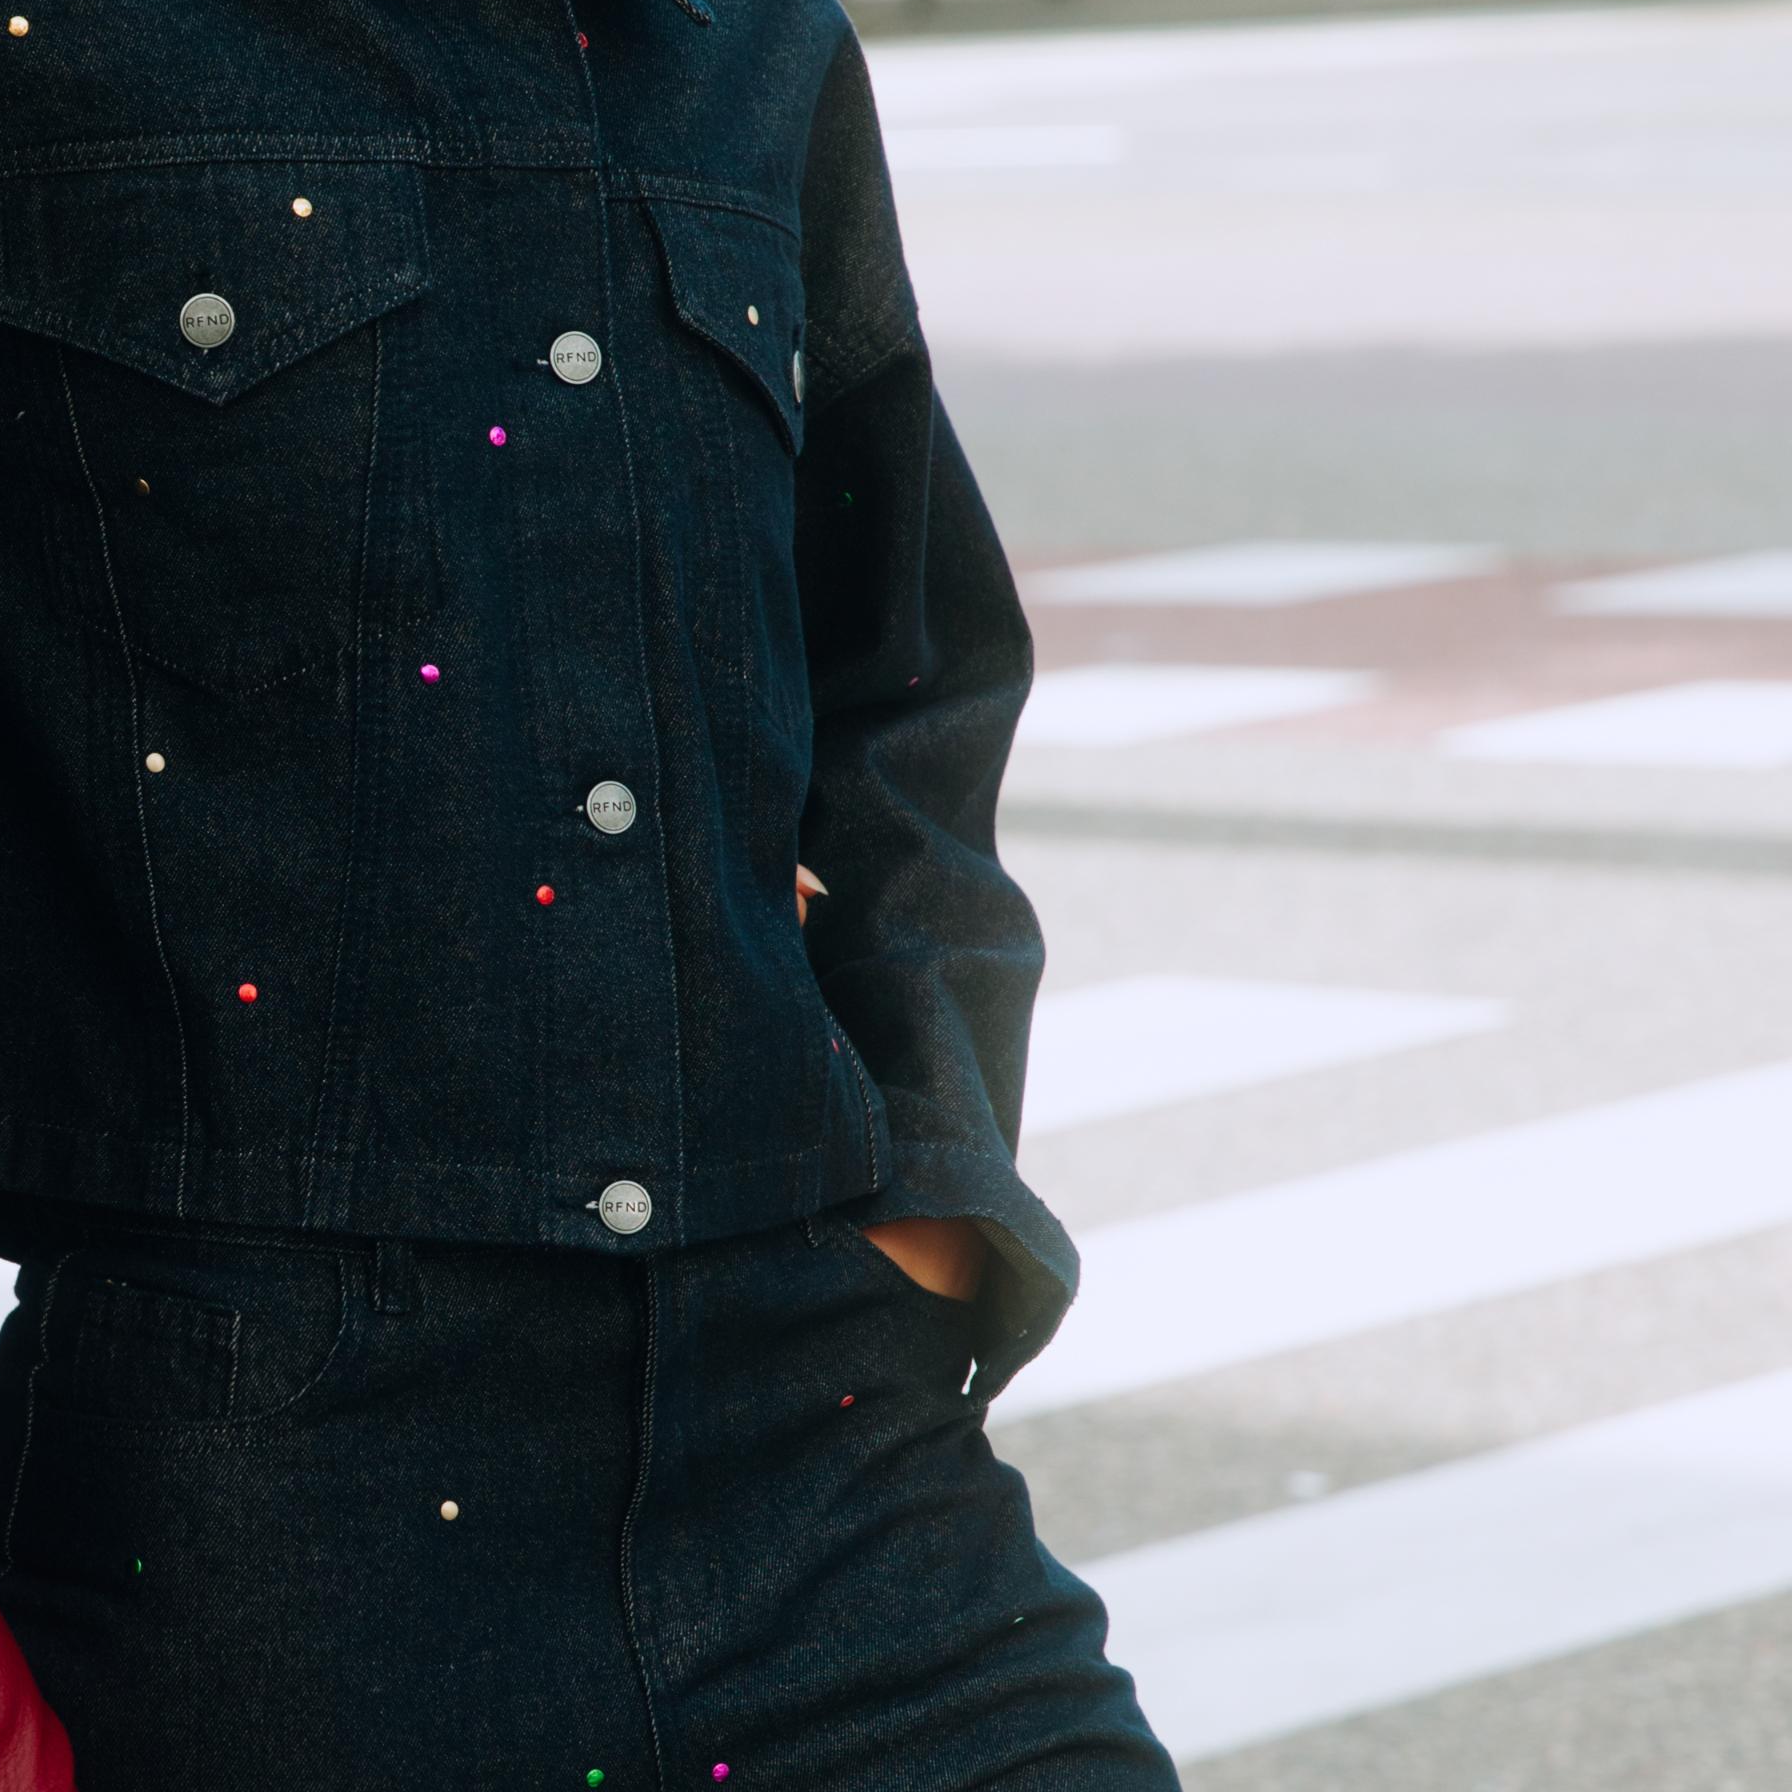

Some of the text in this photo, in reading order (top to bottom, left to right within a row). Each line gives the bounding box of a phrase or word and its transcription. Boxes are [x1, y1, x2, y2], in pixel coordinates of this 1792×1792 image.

[186, 314, 229, 328] RFND
[557, 352, 597, 363] RFND
[593, 801, 632, 813] RFND
[605, 1201, 647, 1212] RFND
